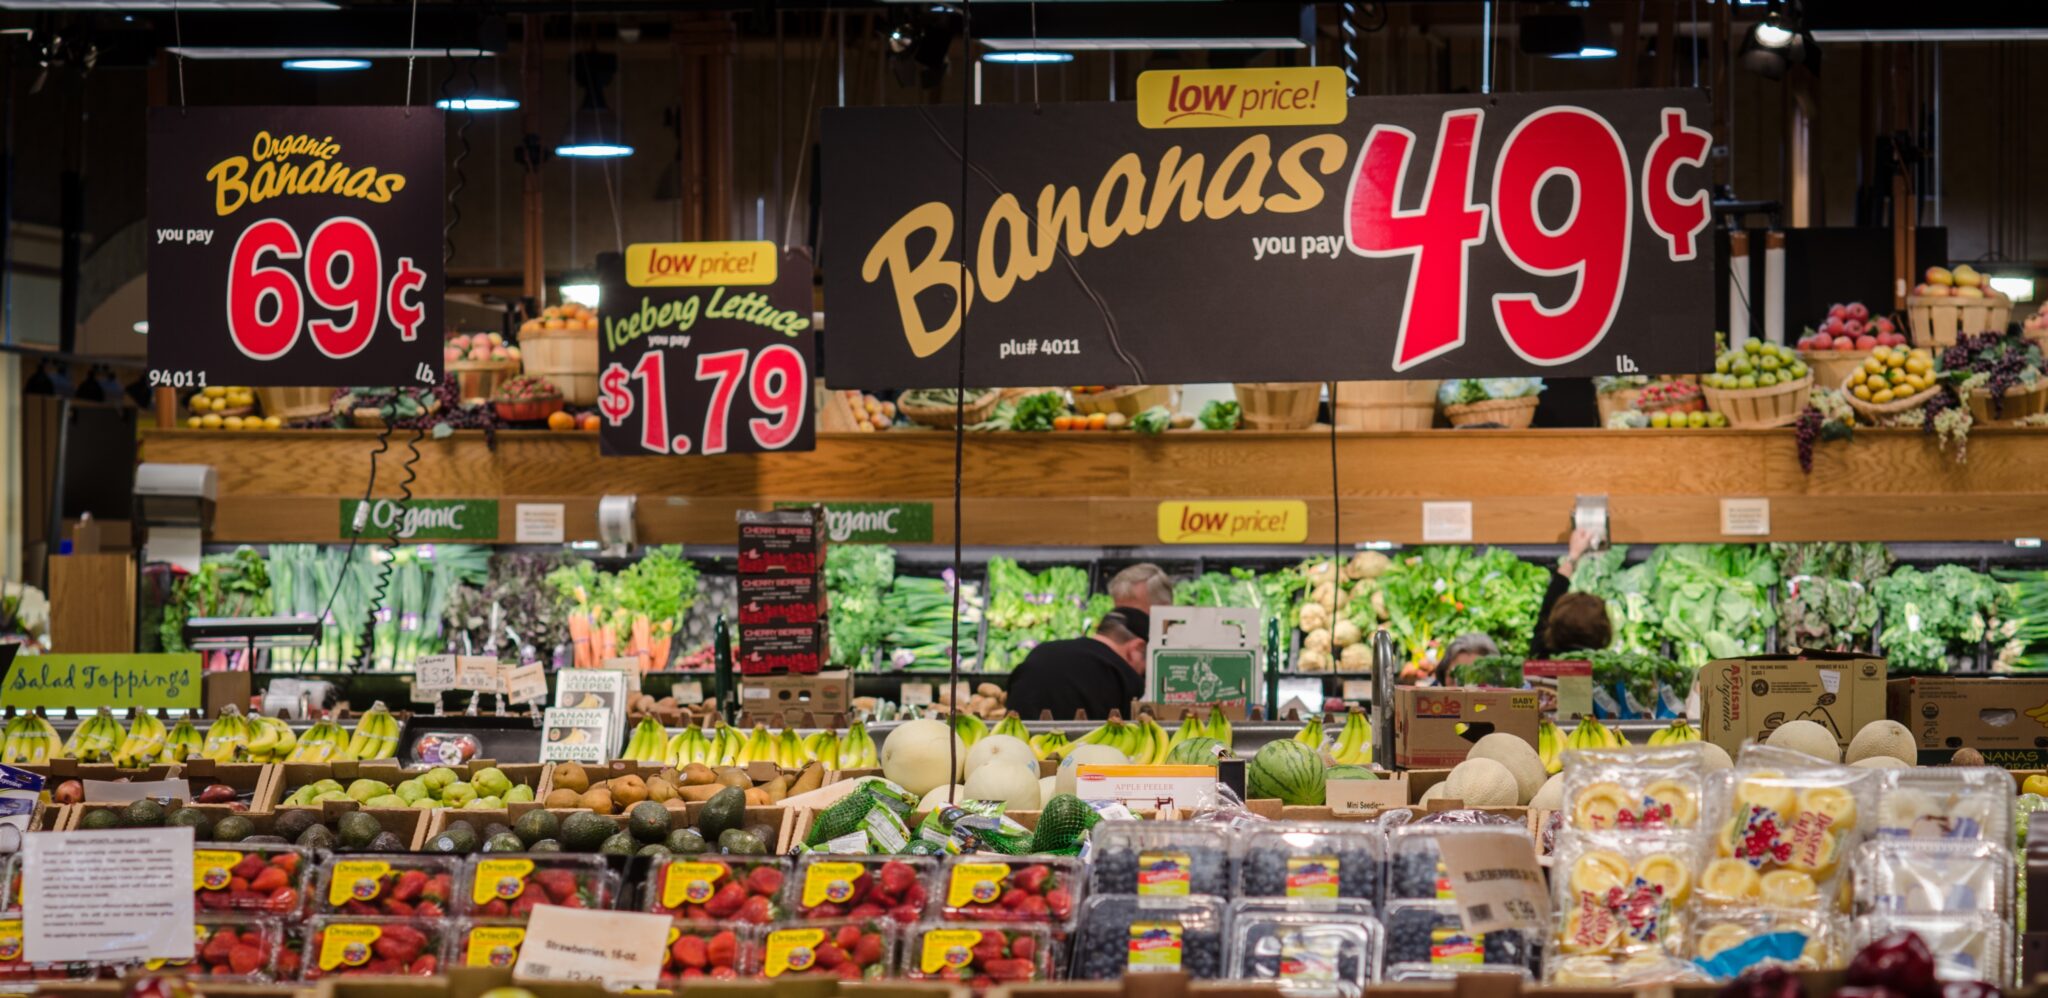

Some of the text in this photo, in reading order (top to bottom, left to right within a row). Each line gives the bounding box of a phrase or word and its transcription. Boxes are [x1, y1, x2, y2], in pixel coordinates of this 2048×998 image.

[1167, 75, 1320, 119] low price!
[252, 130, 341, 162] Organic
[206, 155, 406, 216] Bananas
[157, 229, 213, 245] you pay
[861, 132, 1348, 359] Bananas
[1252, 234, 1344, 260] you pay
[648, 248, 757, 279] low price!
[605, 286, 810, 352] Iceberg Lettuce
[648, 336, 691, 348] you pay
[1000, 338, 1080, 360] plu# 4011
[415, 362, 437, 385] lb.
[1616, 355, 1639, 373] lb.
[149, 369, 207, 388] 94011
[598, 344, 808, 455] $1.79
[824, 507, 900, 542] rganic
[1180, 506, 1289, 537] low price!
[9, 664, 190, 699] Salad Toppings
[1730, 664, 1743, 721] Artisan
[1416, 695, 1462, 714] Dole
[1512, 697, 1534, 705] BABY
[550, 711, 602, 719] BANANA
[1981, 751, 2039, 761] NANAS
[1115, 783, 1174, 791] APPLE PEELER
[1346, 801, 1384, 809] Mini Seedle
